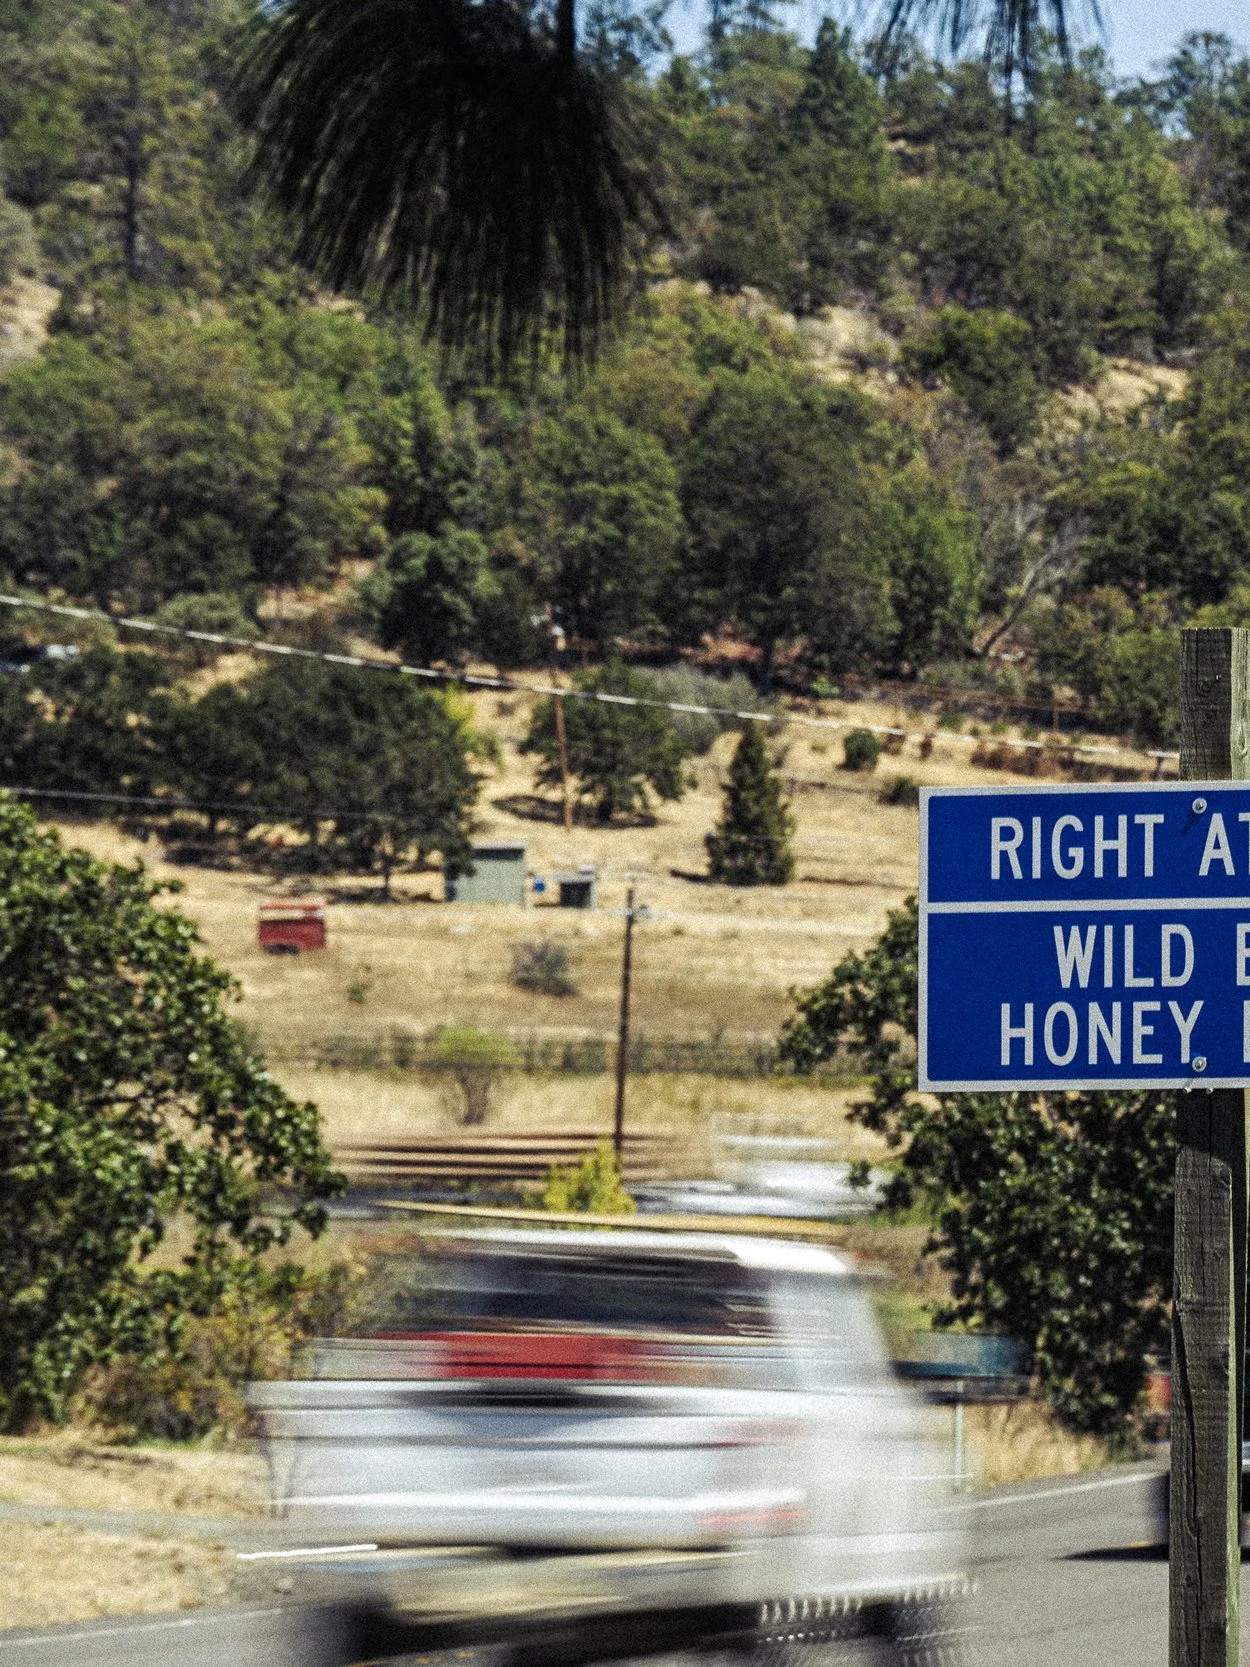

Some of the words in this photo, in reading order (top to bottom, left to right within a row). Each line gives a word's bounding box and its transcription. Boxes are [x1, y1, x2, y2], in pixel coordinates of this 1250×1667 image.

[990, 814, 1165, 880] RIGHT
[1053, 923, 1195, 989] WILD
[1000, 1000, 1204, 1066] HONEY
